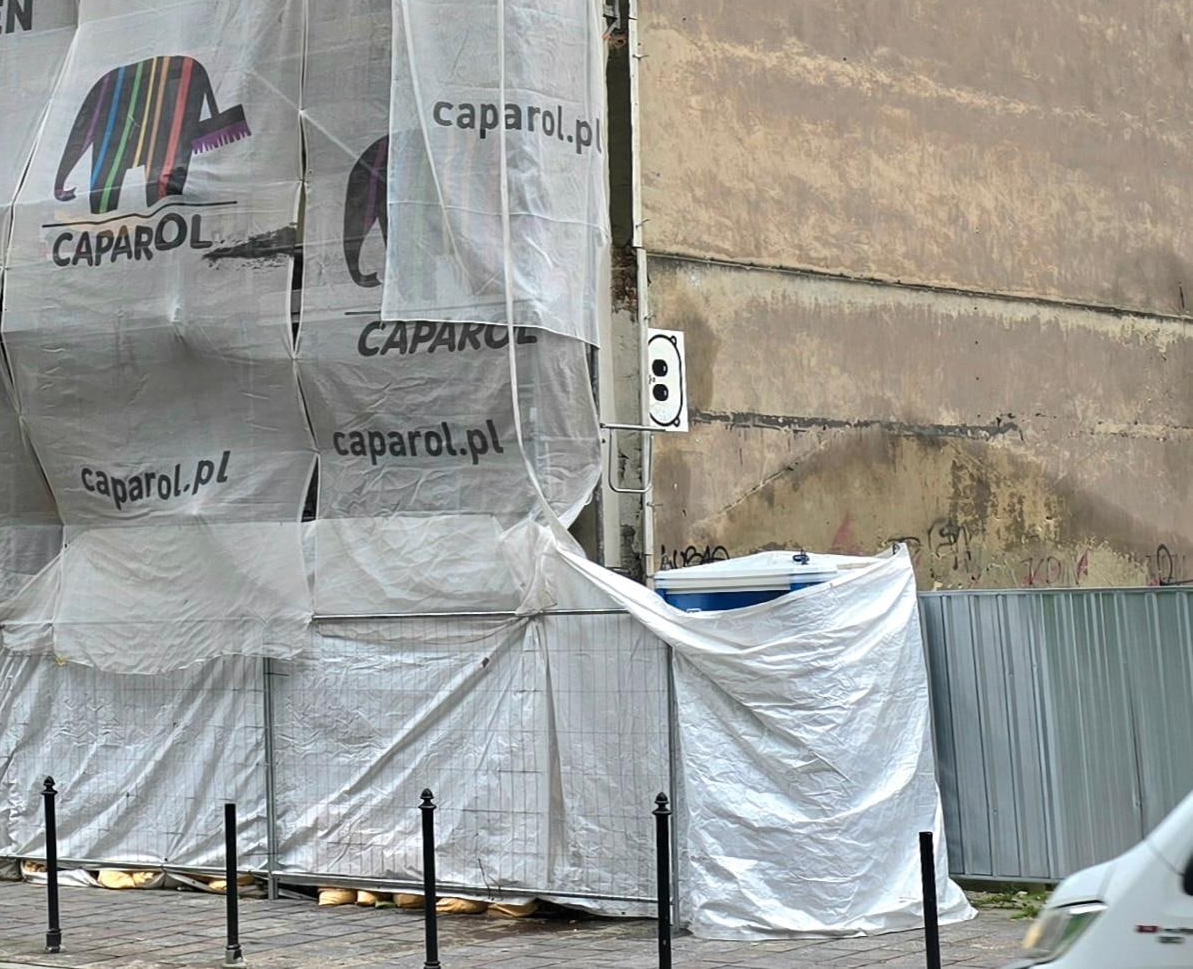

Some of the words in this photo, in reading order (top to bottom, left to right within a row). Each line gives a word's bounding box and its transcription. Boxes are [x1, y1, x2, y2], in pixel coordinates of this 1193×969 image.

[433, 99, 604, 154] caparol.pl
[52, 212, 213, 267] CAPAROL
[333, 419, 504, 465] caparol.pl
[81, 451, 231, 511] caparol.pl
